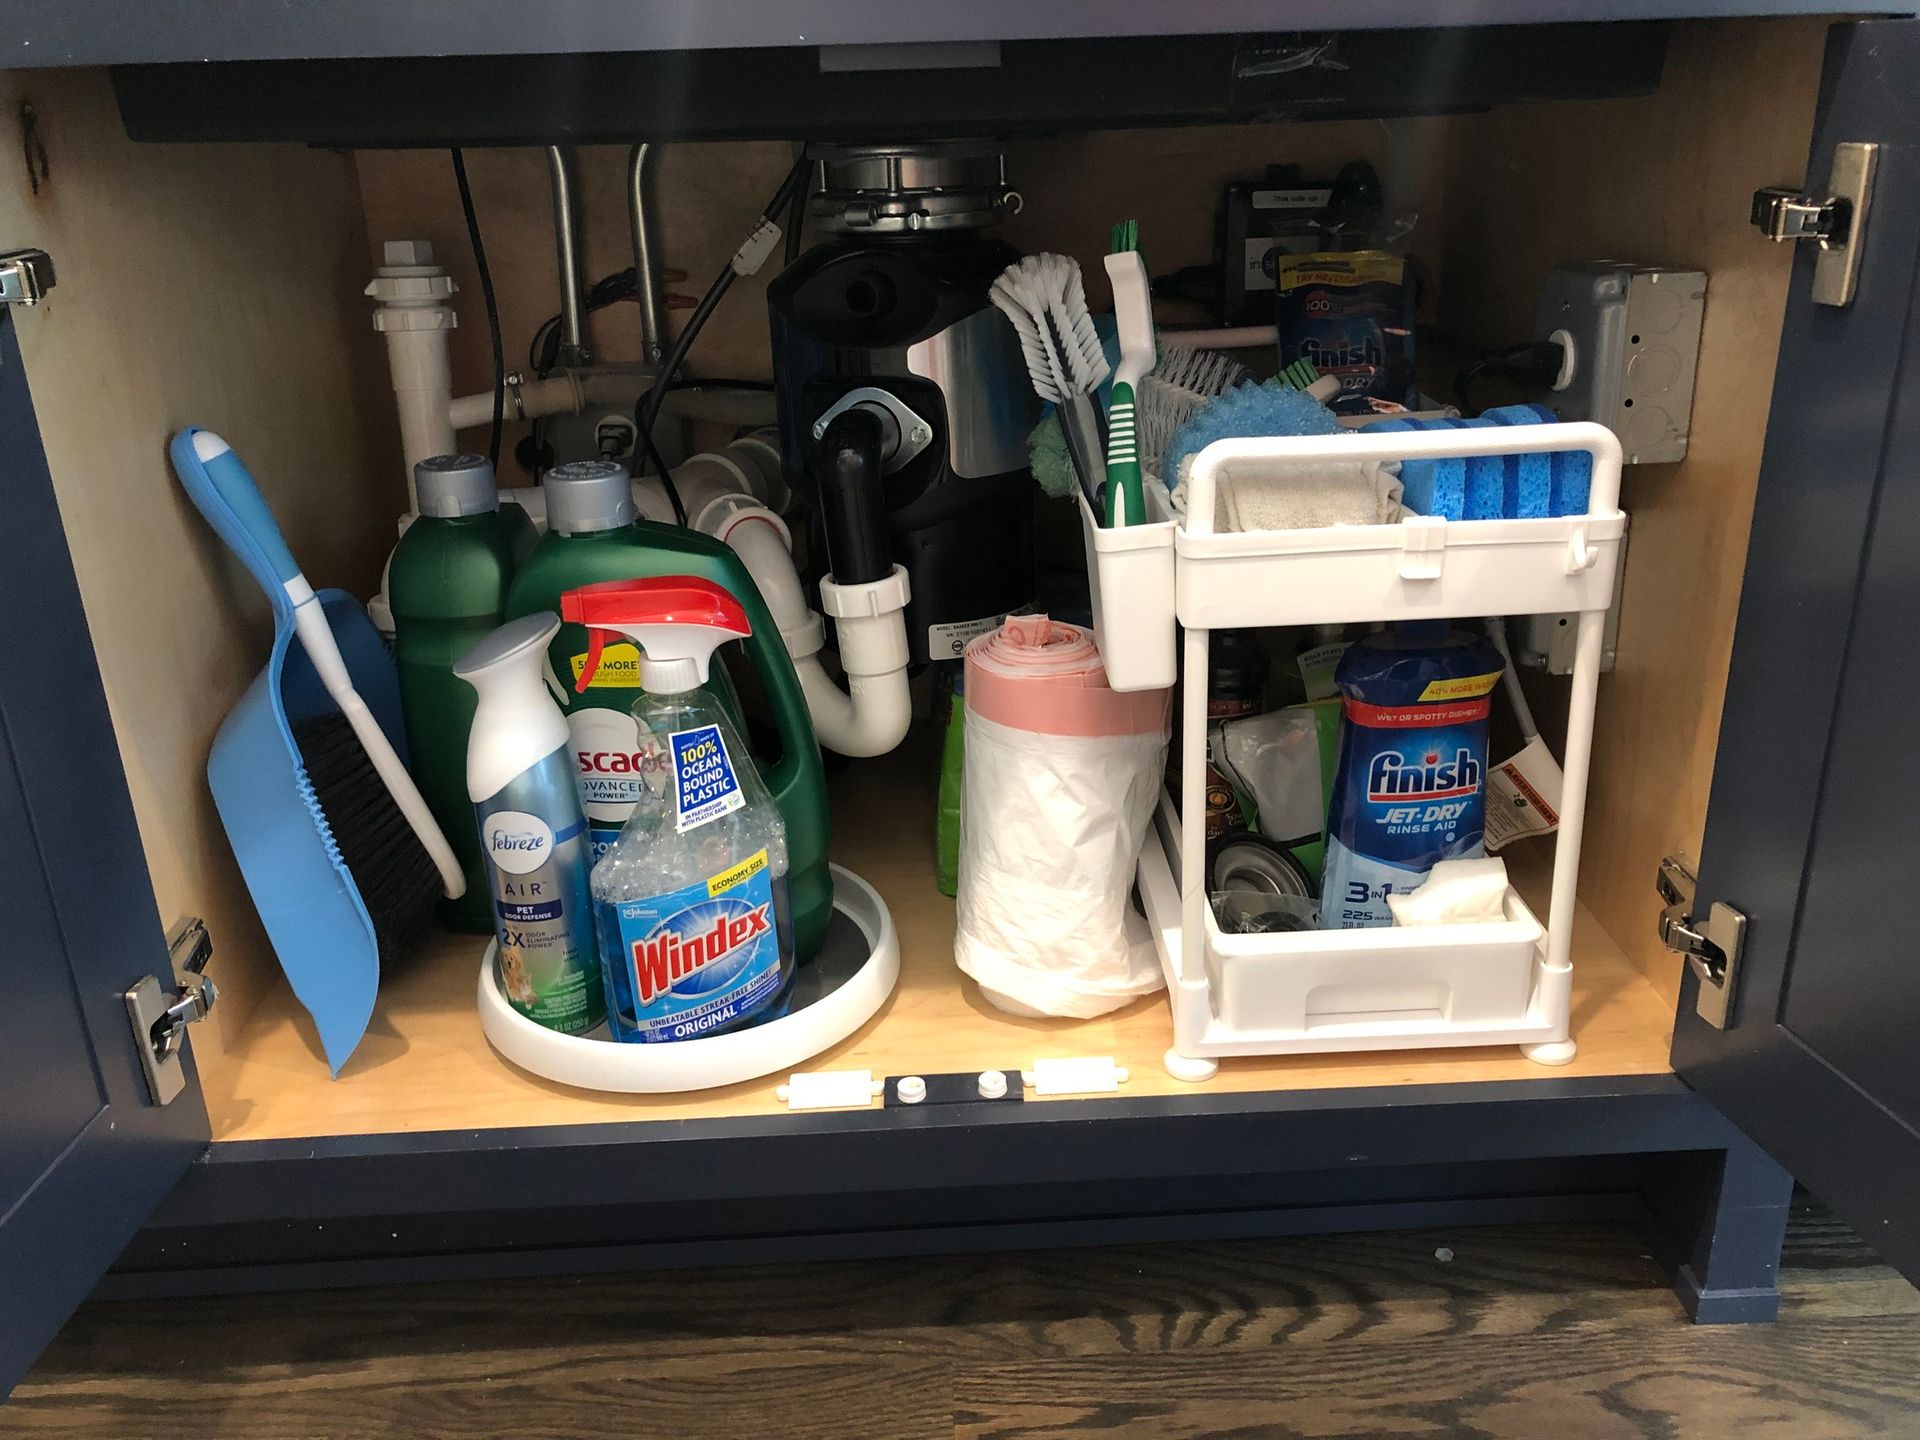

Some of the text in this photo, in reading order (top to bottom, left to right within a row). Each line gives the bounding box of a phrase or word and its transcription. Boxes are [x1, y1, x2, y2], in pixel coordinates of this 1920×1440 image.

[1300, 336, 1382, 368] finish
[603, 661, 638, 670] MORE
[1414, 711, 1447, 721] SPOTTY
[681, 739, 718, 765] 100%
[682, 753, 722, 779] OCEAN
[1369, 749, 1479, 794] finish
[683, 767, 723, 793] BOUND
[683, 777, 731, 807] PLASTIC
[1376, 802, 1468, 824] JET-DRY
[1387, 820, 1457, 834] RINSE AID
[492, 829, 544, 851] febreze
[711, 868, 749, 891] ECONOMY
[749, 857, 763, 872] SIZE
[504, 882, 542, 897] AIR
[1345, 881, 1370, 903] 3
[516, 906, 534, 915] PET
[522, 912, 552, 921] DEFENSE
[1343, 910, 1373, 921] 225
[502, 928, 526, 949] 2X
[526, 931, 570, 944] ELIMINATING
[633, 904, 768, 1002] Windex
[649, 1008, 701, 1028] UNBEATABLE
[700, 985, 749, 1013] STREAK-FREE
[674, 1005, 738, 1037] ORIGINAL
